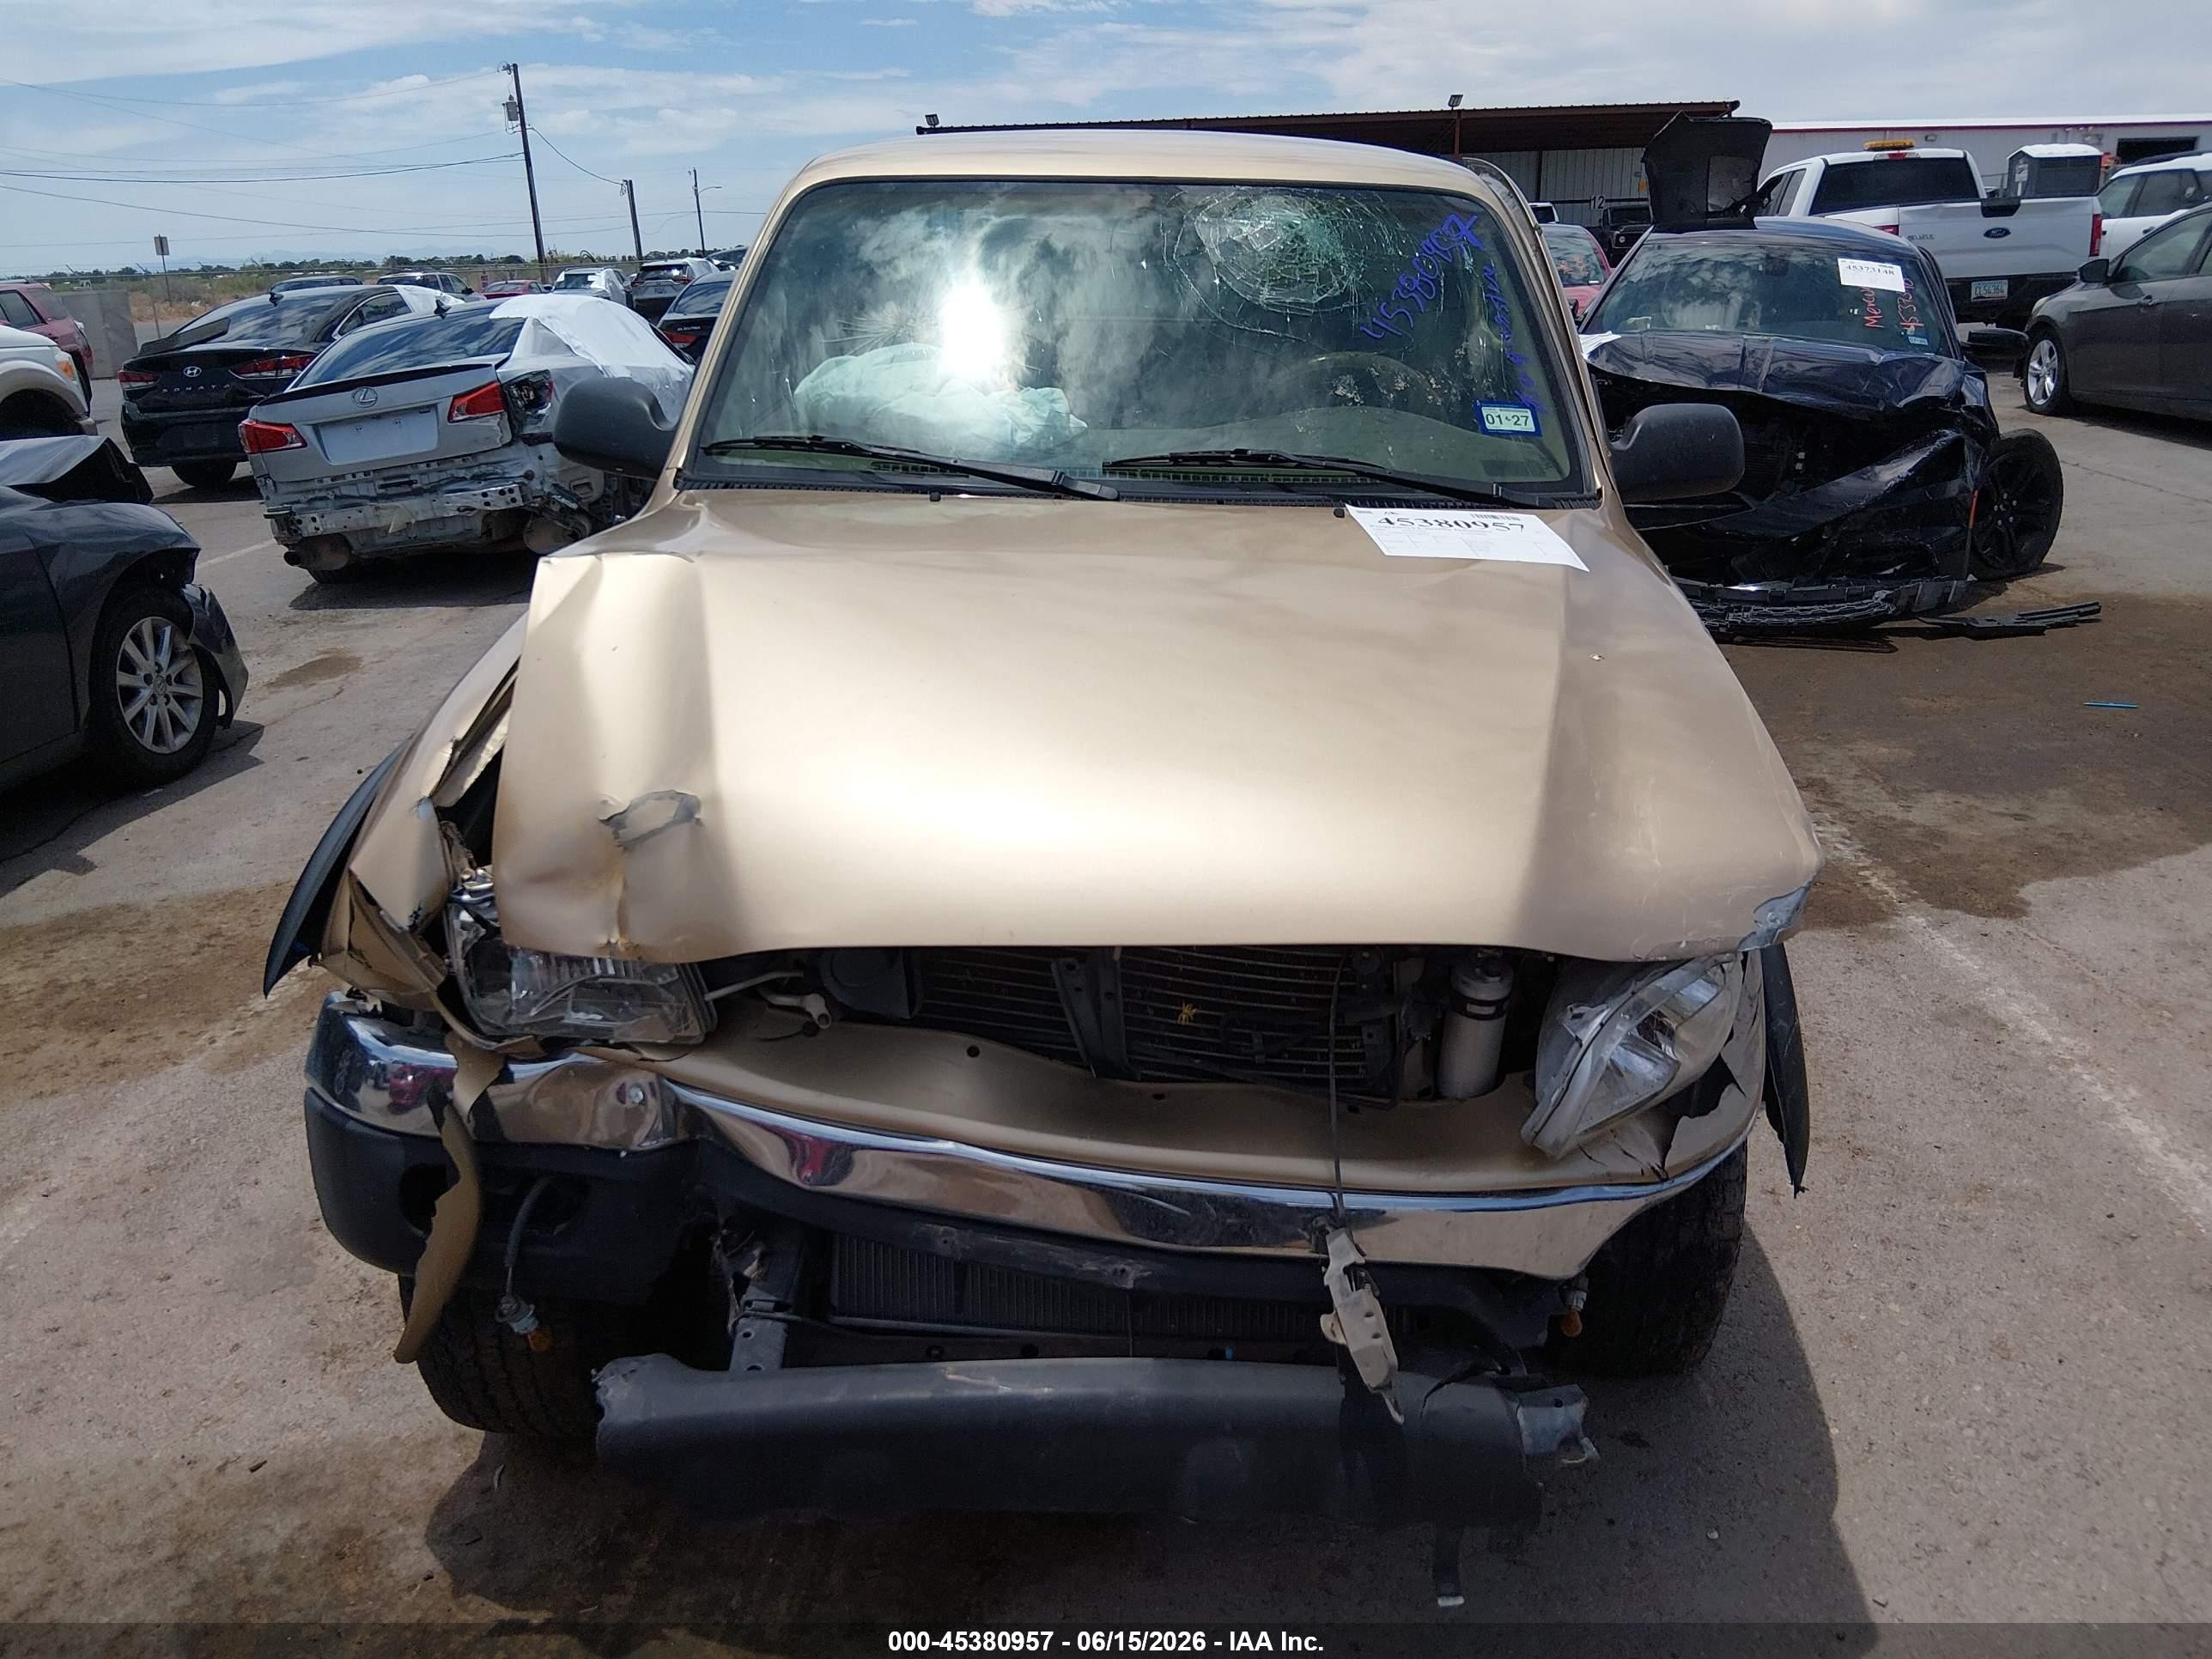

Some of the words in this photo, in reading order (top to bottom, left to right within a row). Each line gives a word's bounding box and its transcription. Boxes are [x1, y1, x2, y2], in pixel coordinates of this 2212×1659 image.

[1591, 196, 1605, 209] 12
[161, 384, 231, 392] SONATA
[1486, 413, 1503, 425] 01
[1511, 415, 1529, 426] 27
[1377, 516, 1524, 533] 45380957
